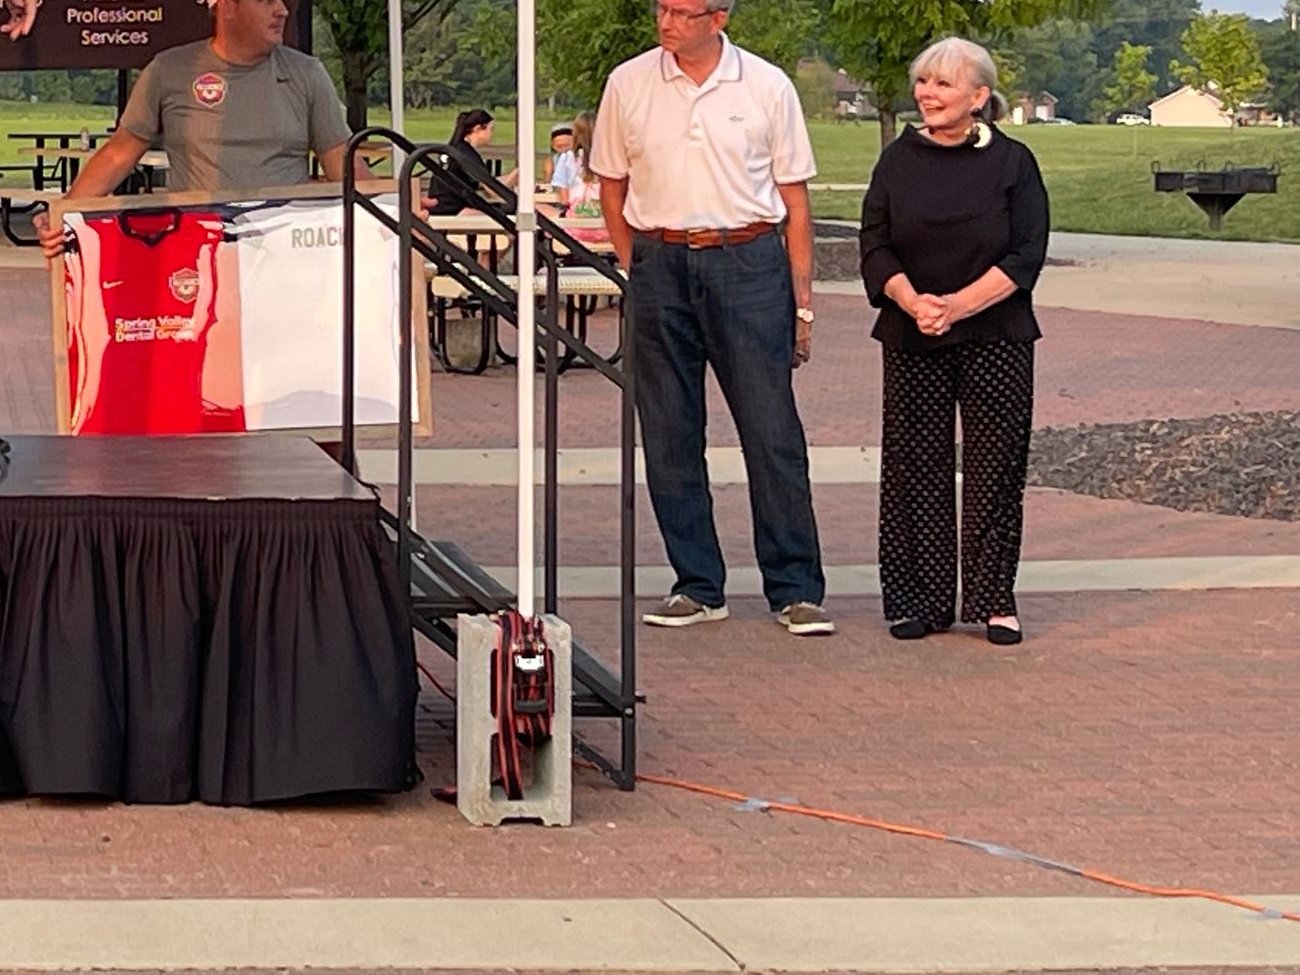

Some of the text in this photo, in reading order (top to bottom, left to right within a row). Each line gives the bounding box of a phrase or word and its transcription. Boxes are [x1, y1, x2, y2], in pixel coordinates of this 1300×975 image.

[67, 7, 163, 23] Professional
[81, 29, 149, 45] Services
[115, 317, 156, 332] Spring
